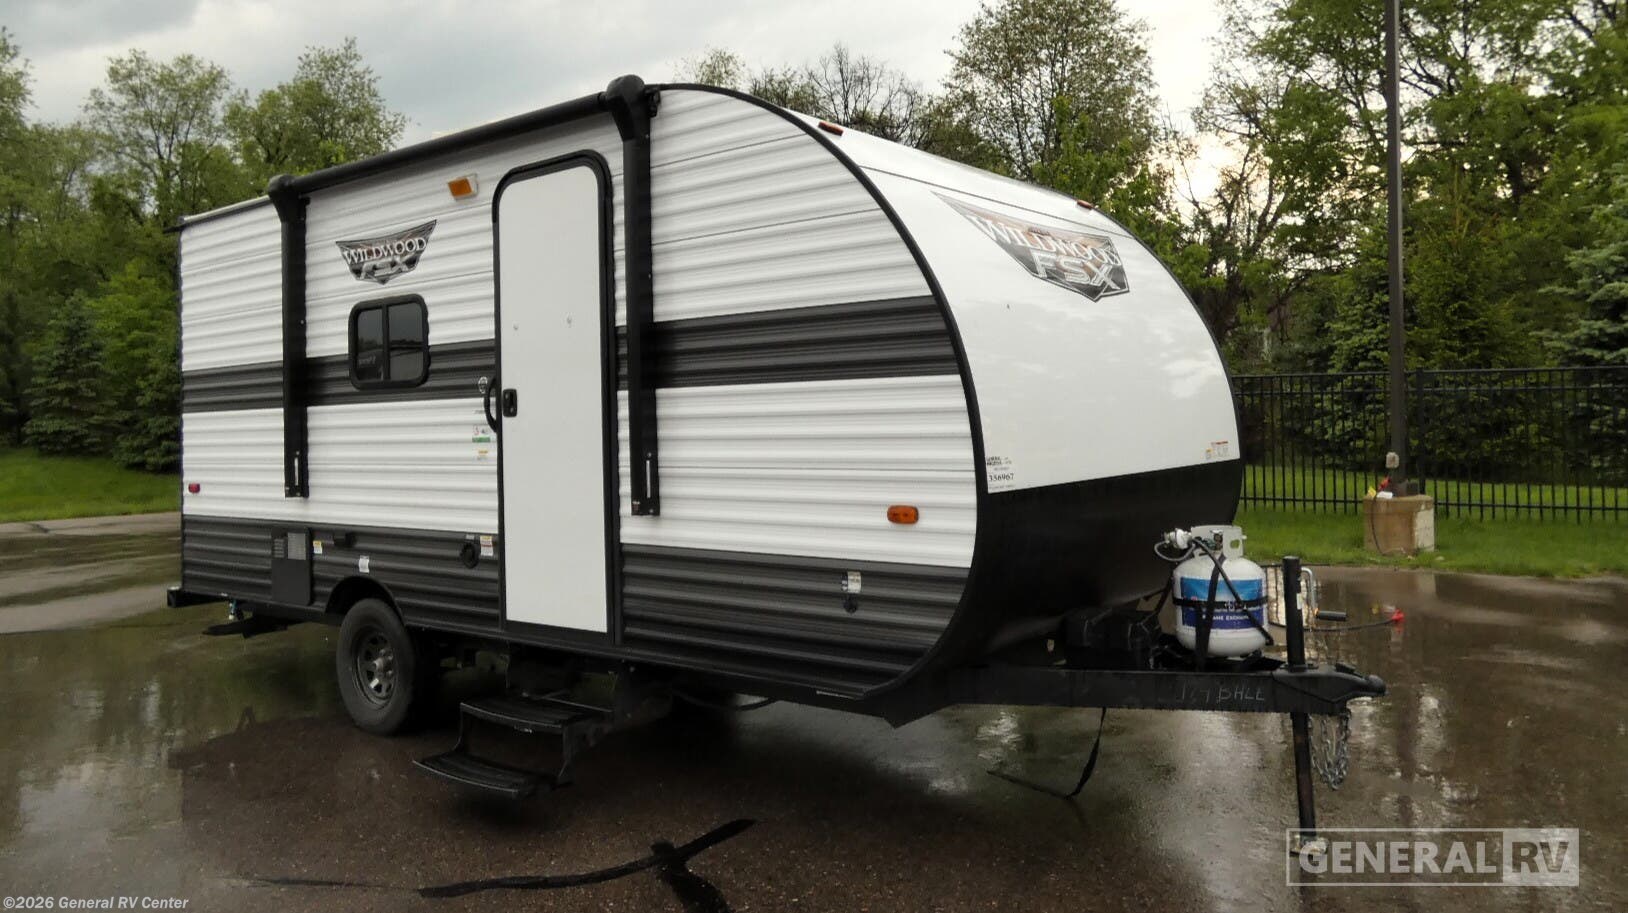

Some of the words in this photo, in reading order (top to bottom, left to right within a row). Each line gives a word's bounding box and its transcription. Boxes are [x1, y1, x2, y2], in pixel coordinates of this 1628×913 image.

[344, 237, 426, 265] WILDWOOD
[966, 214, 1122, 266] WILDWOOD
[1031, 250, 1121, 290] FSX
